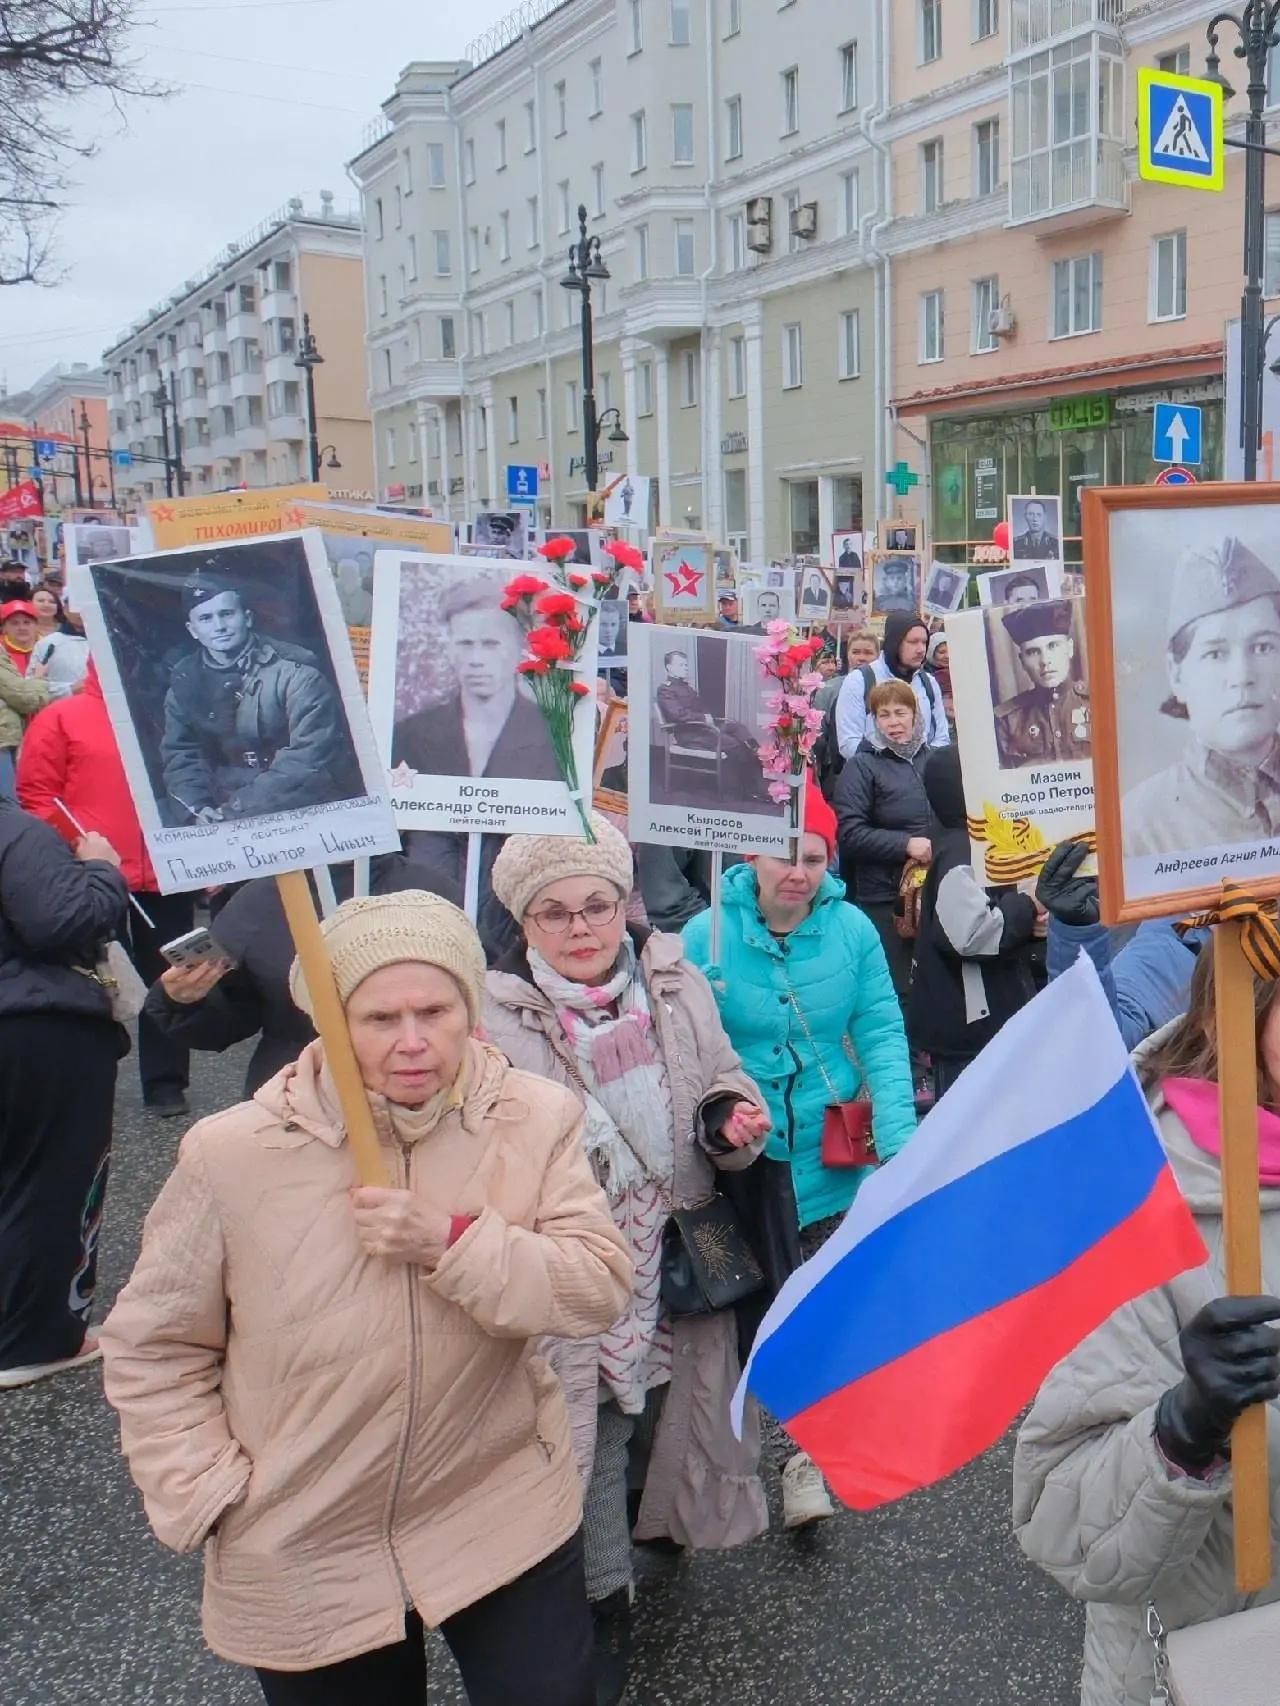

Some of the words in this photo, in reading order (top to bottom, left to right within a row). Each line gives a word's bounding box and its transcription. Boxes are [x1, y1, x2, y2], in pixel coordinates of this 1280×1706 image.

[327, 488, 374, 500] ОПТИКА
[194, 518, 284, 540] ТИХОМИРО
[1030, 771, 1081, 785] Мазеин
[459, 785, 499, 798] Югов
[1001, 792, 1046, 804] Федор
[391, 798, 472, 815] Александр
[477, 801, 567, 817] Степанович
[449, 817, 506, 827] лейтенант
[649, 822, 702, 836] Алексей
[705, 827, 785, 846] Григорьевич
[1154, 856, 1219, 875] Андреева
[1220, 850, 1257, 865] Агния
